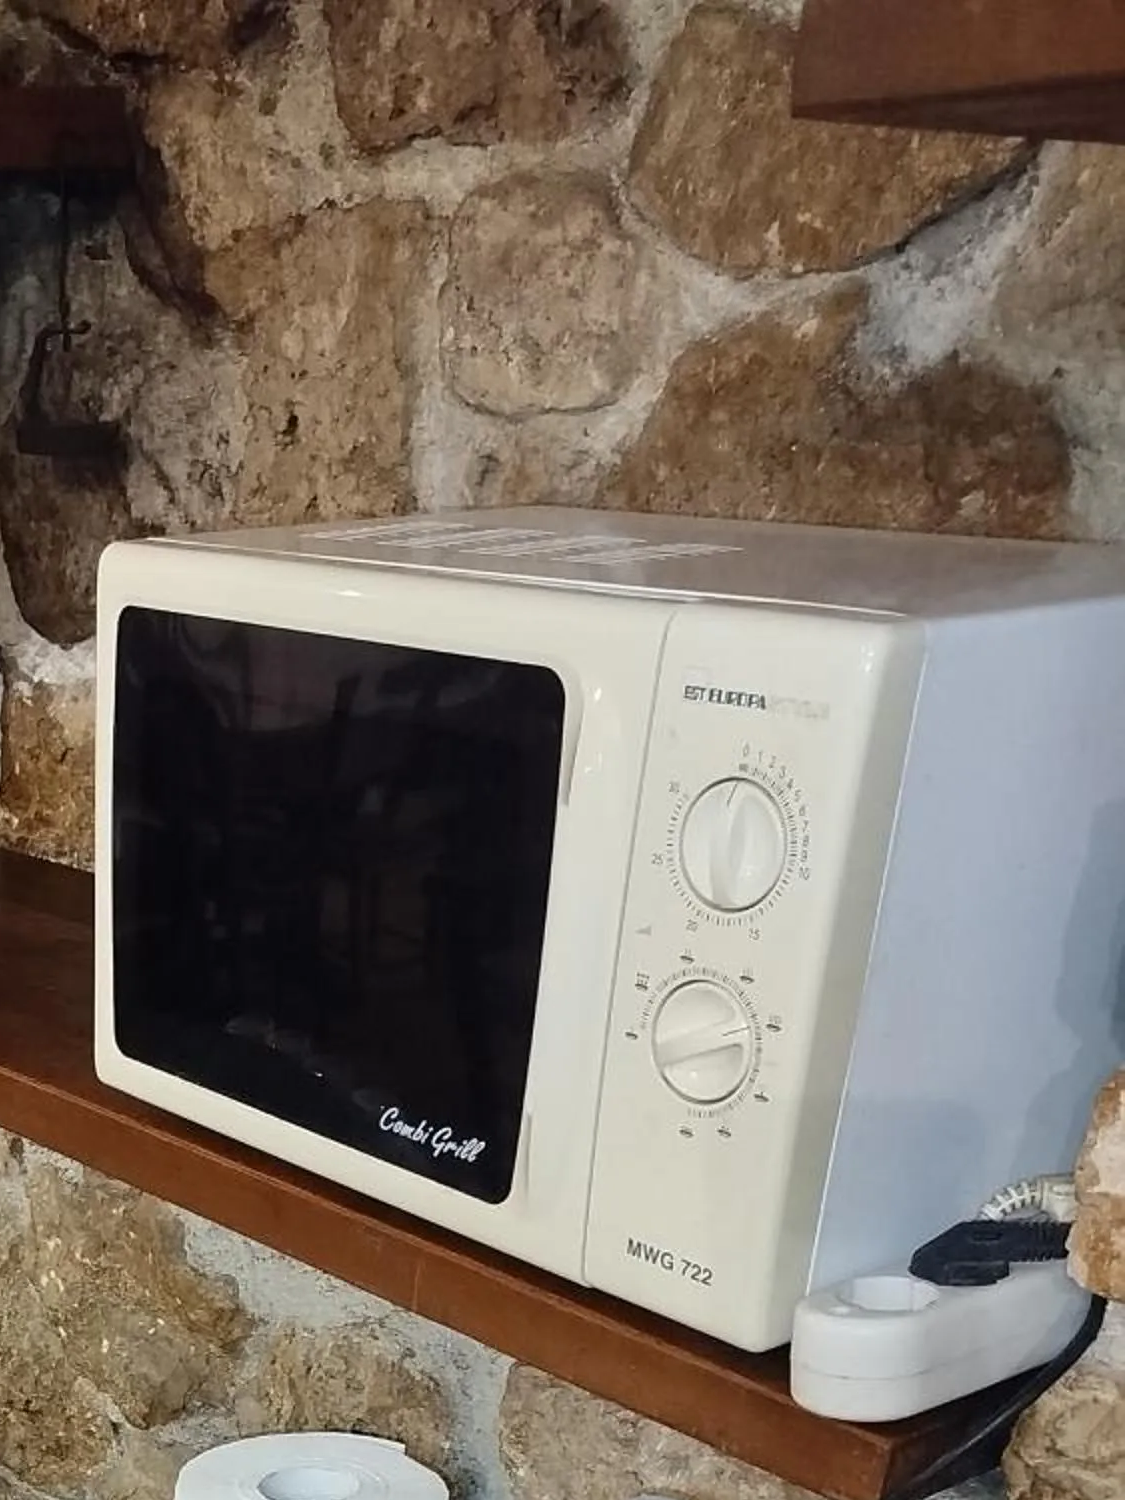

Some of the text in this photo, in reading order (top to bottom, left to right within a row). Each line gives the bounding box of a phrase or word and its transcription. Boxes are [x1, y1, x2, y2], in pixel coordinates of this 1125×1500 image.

[379, 1107, 487, 1163] Combi Grill
[626, 1237, 714, 1287] MWG 722
